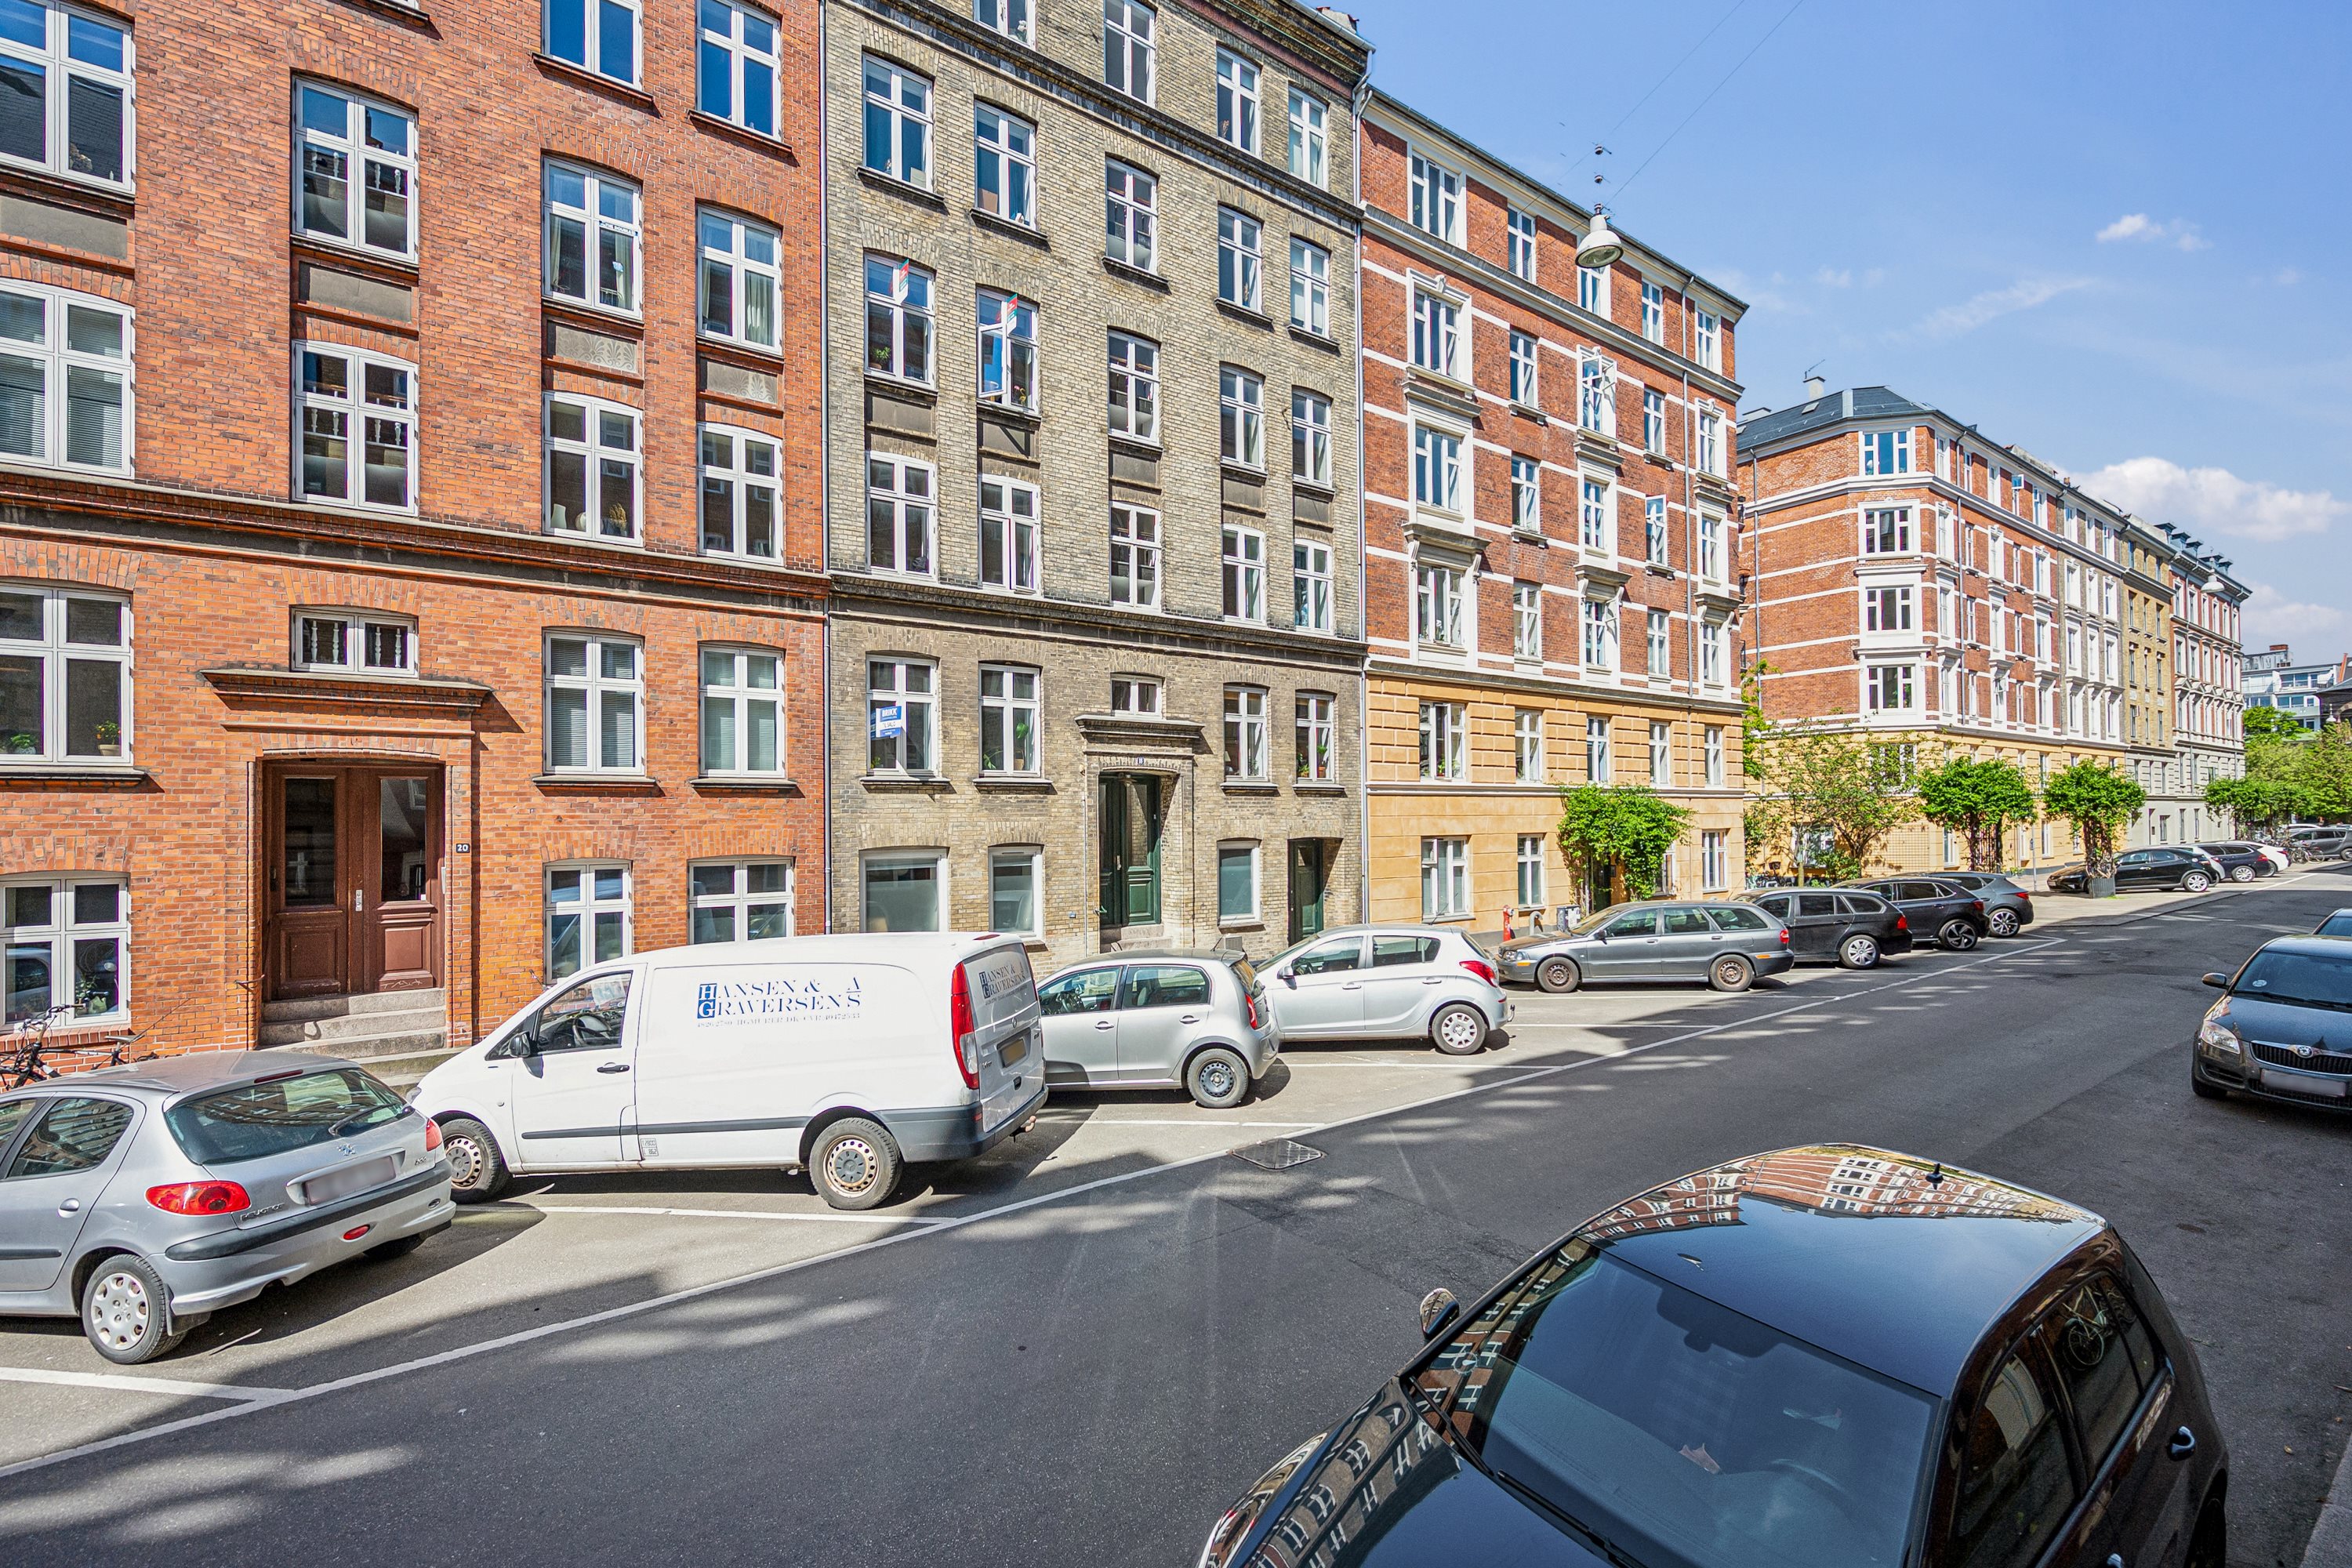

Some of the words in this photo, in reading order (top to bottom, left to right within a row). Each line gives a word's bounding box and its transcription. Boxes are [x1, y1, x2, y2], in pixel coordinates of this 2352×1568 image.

[979, 965, 1010, 985] HANSEN
[699, 980, 797, 1000] HANSEN
[804, 978, 820, 993] &
[697, 995, 841, 1018] GRAVERSEN
